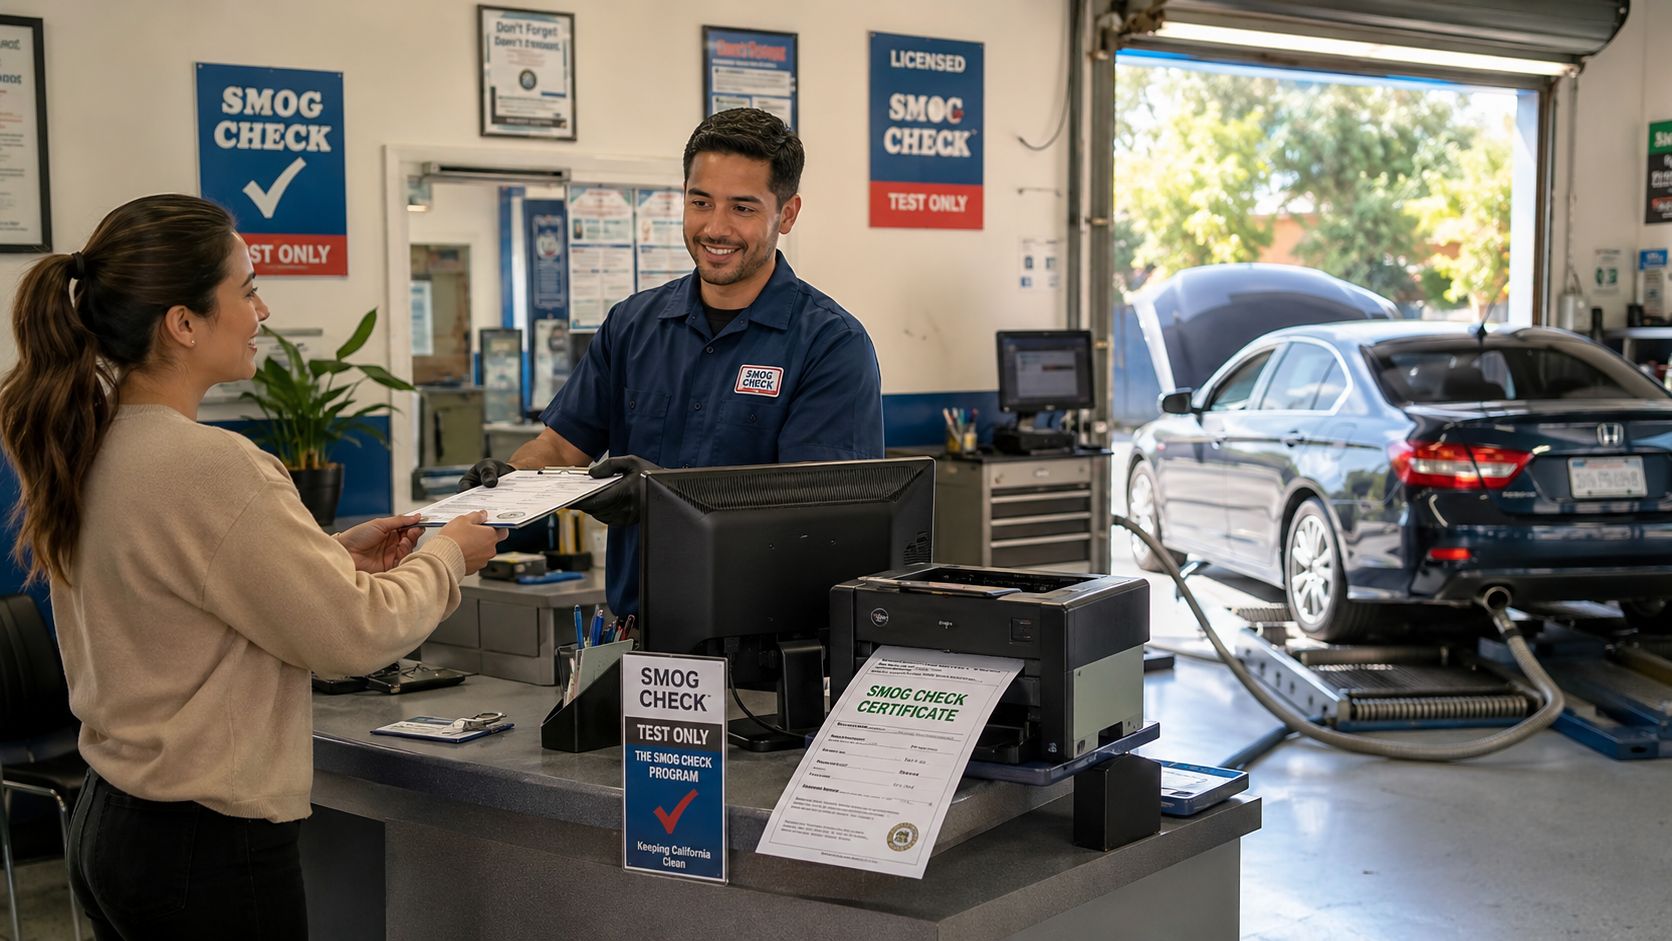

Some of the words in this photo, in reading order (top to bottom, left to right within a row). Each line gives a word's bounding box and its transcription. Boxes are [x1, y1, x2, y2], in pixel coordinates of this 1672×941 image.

[496, 21, 523, 35] Don't
[526, 23, 558, 39] Forget
[890, 49, 966, 73] LICENSED
[221, 85, 323, 119] SMOG
[213, 120, 332, 152] CHECK
[883, 126, 971, 158] CHECK
[888, 192, 927, 211] TEST
[928, 194, 968, 212] ONLY
[249, 244, 274, 264] ST
[278, 244, 331, 264] ONLY
[742, 379, 774, 389] CHECK
[745, 369, 773, 380] SMOG
[641, 666, 700, 689] SMOG
[639, 689, 708, 712] CHECK
[866, 685, 913, 701] SMOG
[913, 689, 969, 706] CHECK
[857, 700, 959, 722] CERTIFICATE
[637, 723, 671, 743] TEST
[673, 727, 709, 745] ONLY
[635, 750, 652, 762] THE
[653, 752, 680, 766] SMOG
[681, 754, 713, 769] CHECK
[649, 766, 699, 783] PROGRAM
[637, 840, 670, 858] Keeping
[671, 844, 711, 860] California
[662, 856, 686, 869] Clean
